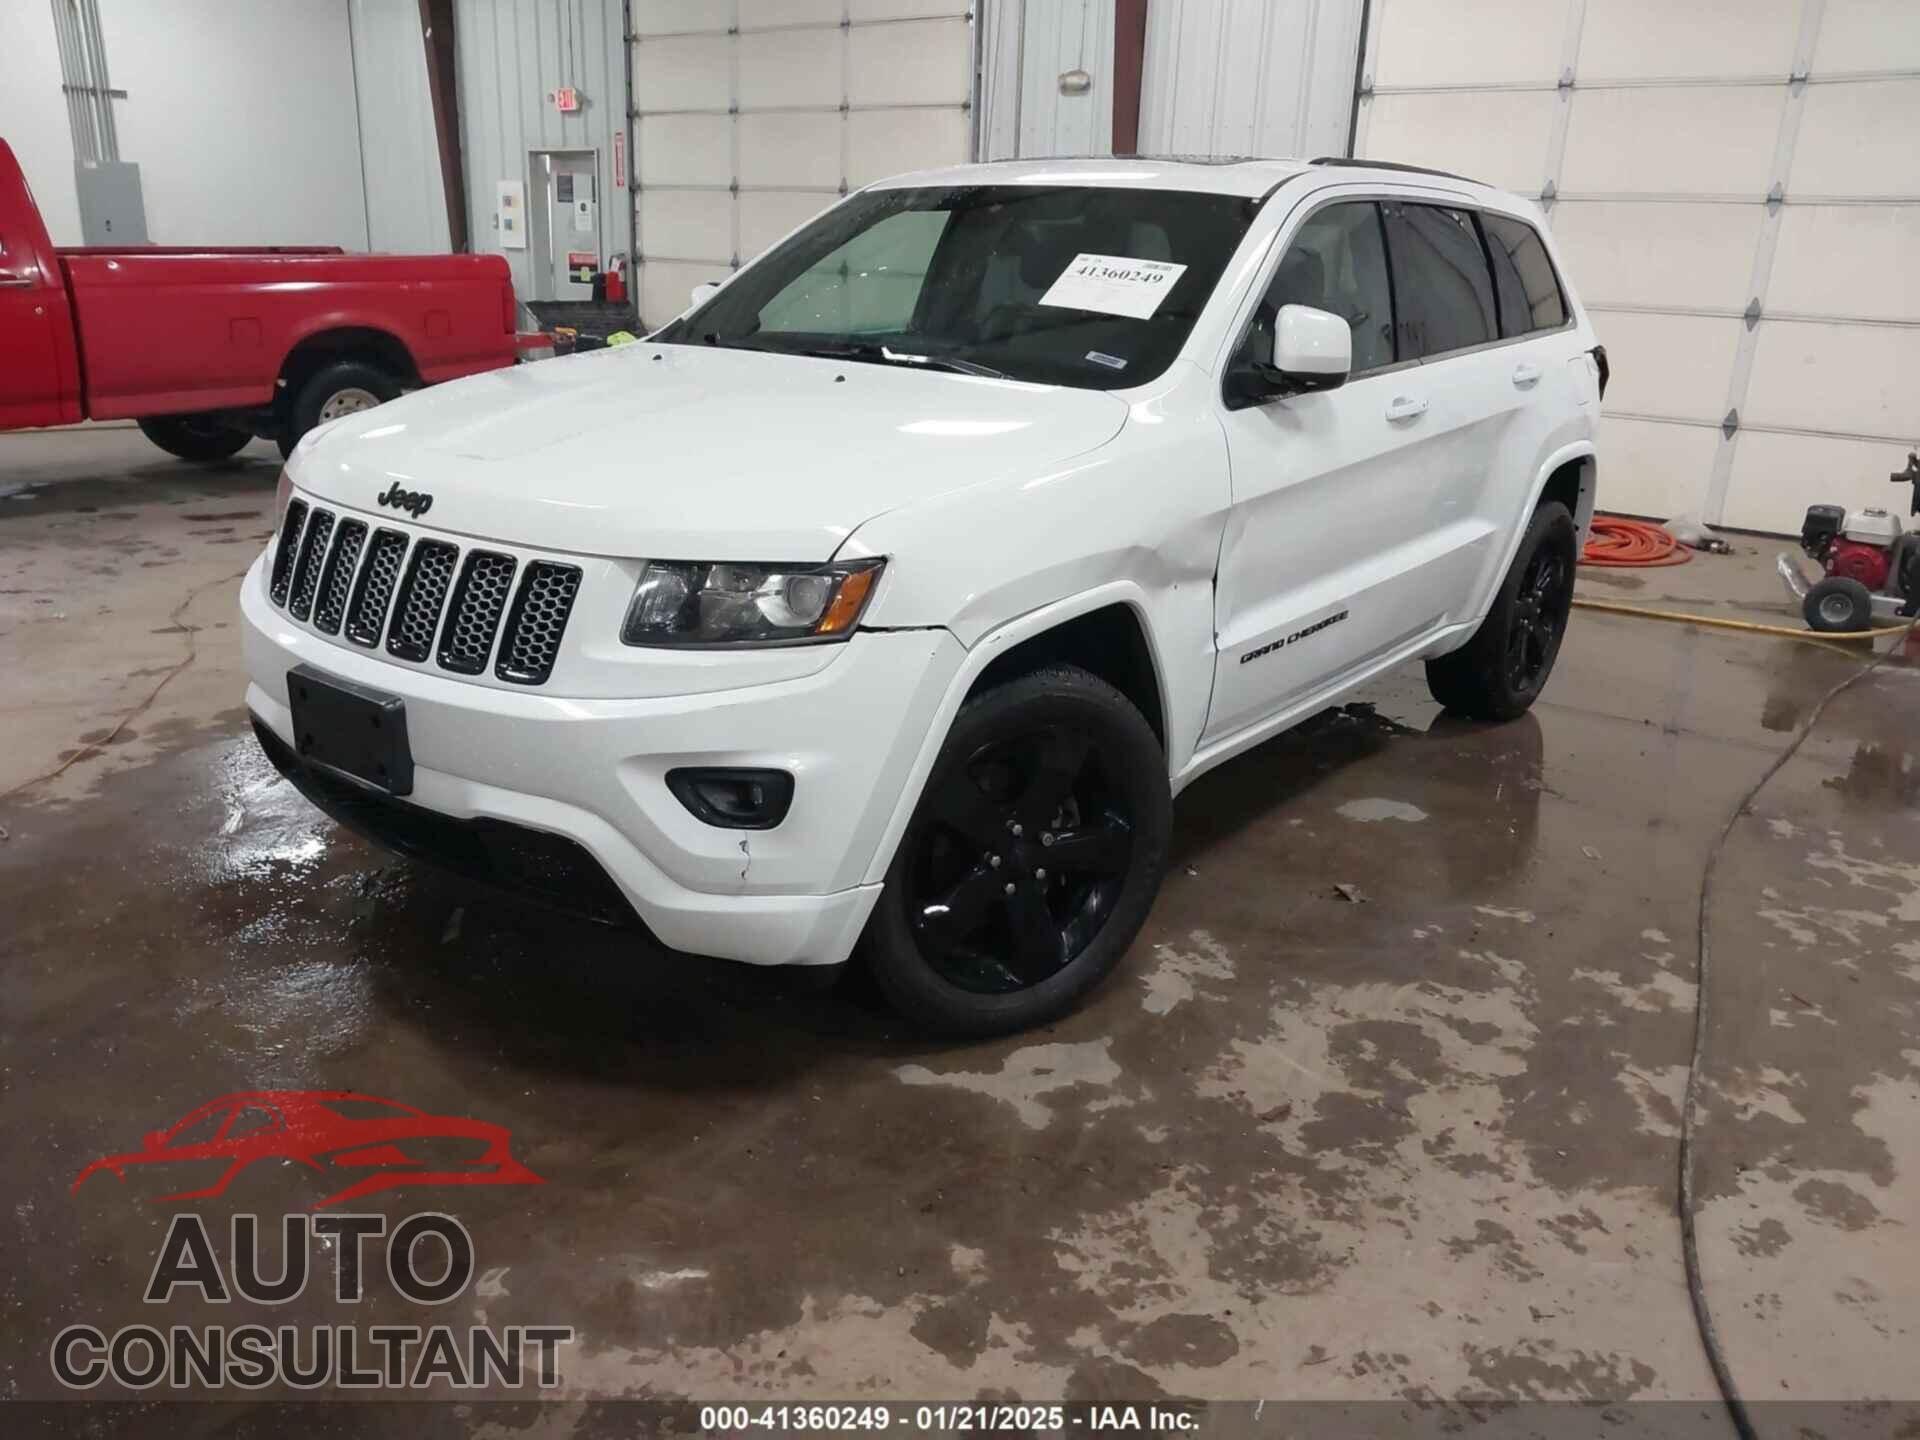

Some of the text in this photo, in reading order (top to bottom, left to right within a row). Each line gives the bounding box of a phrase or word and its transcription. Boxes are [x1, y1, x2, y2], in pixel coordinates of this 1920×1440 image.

[1076, 265, 1164, 283] 41360249
[378, 481, 433, 519] Jeep
[1240, 610, 1349, 664] GRAND CHEROKEE
